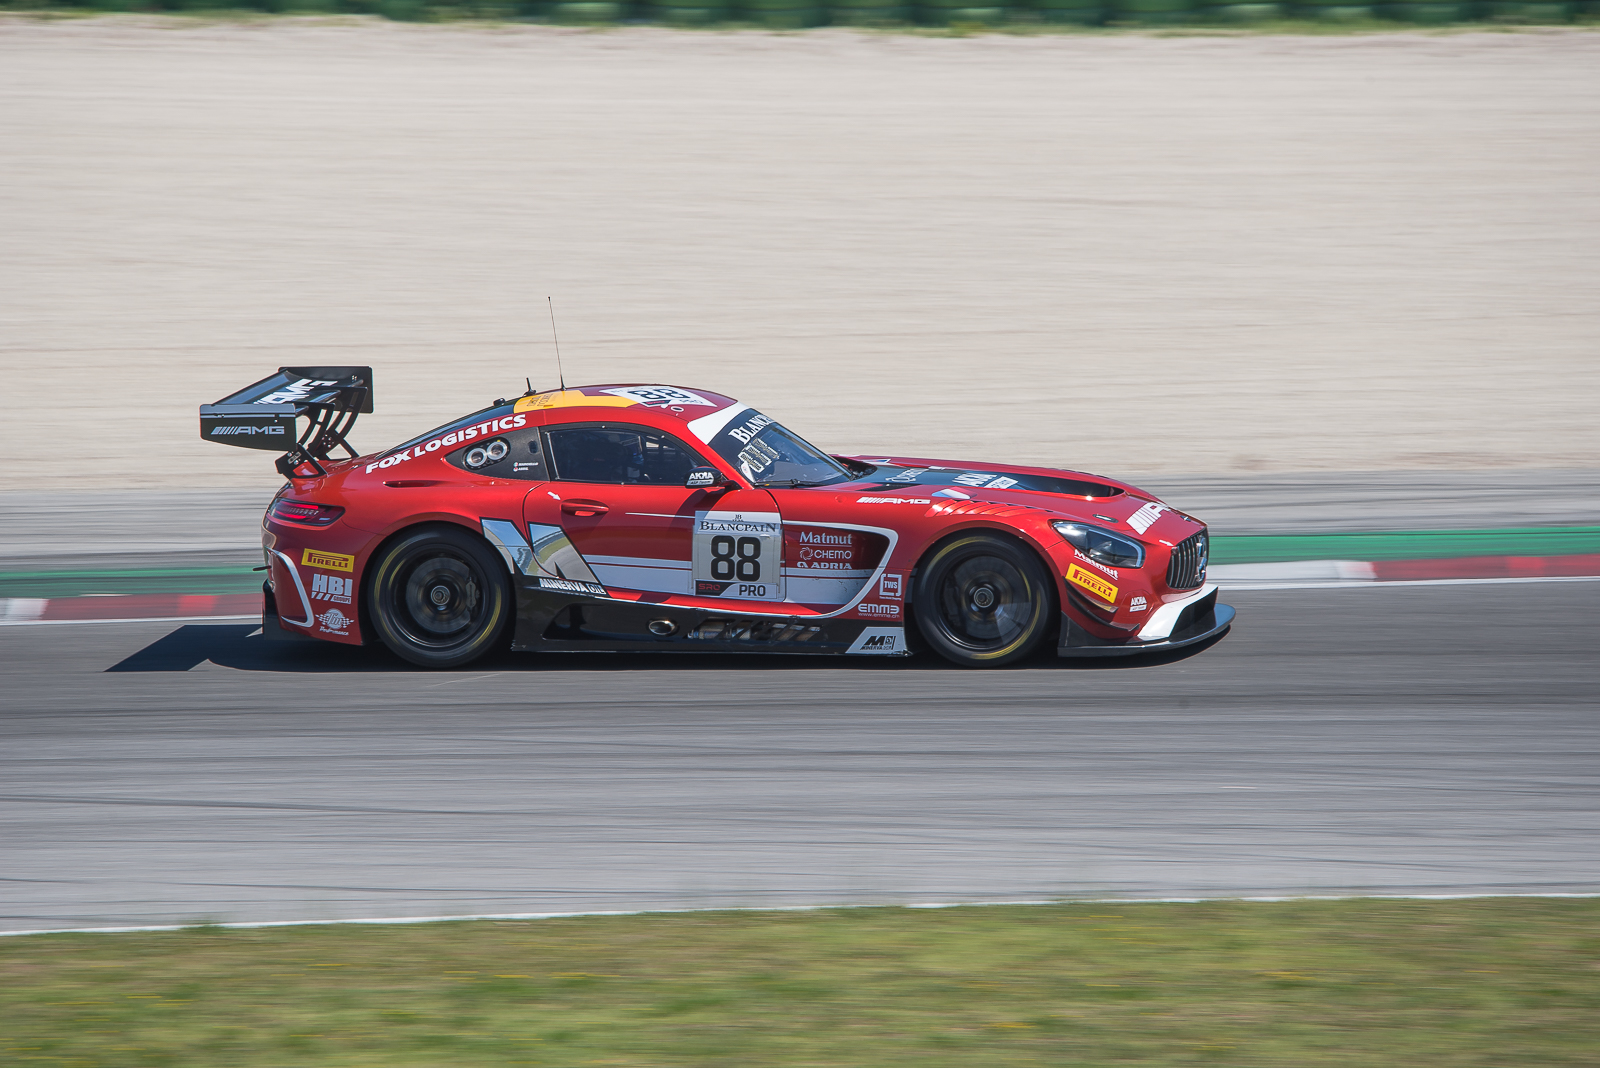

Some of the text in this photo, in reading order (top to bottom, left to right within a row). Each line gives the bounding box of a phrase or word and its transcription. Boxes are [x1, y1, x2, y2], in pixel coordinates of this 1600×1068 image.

[236, 426, 285, 435] AMG
[365, 414, 527, 474] FOX LOGISTICS
[699, 521, 777, 532] BLANCPAIN
[799, 531, 852, 545] Matmut
[307, 552, 349, 568] PIRELLI
[710, 535, 761, 582] 88
[814, 550, 852, 560] CHEMO
[811, 561, 853, 570] ADRIA
[1074, 549, 1119, 579] Matmut
[311, 573, 353, 597] HBI
[539, 577, 590, 593] MINERVA
[698, 583, 766, 597] SRO PRO
[884, 581, 898, 589] TWS
[1072, 569, 1114, 598] PIRELLI
